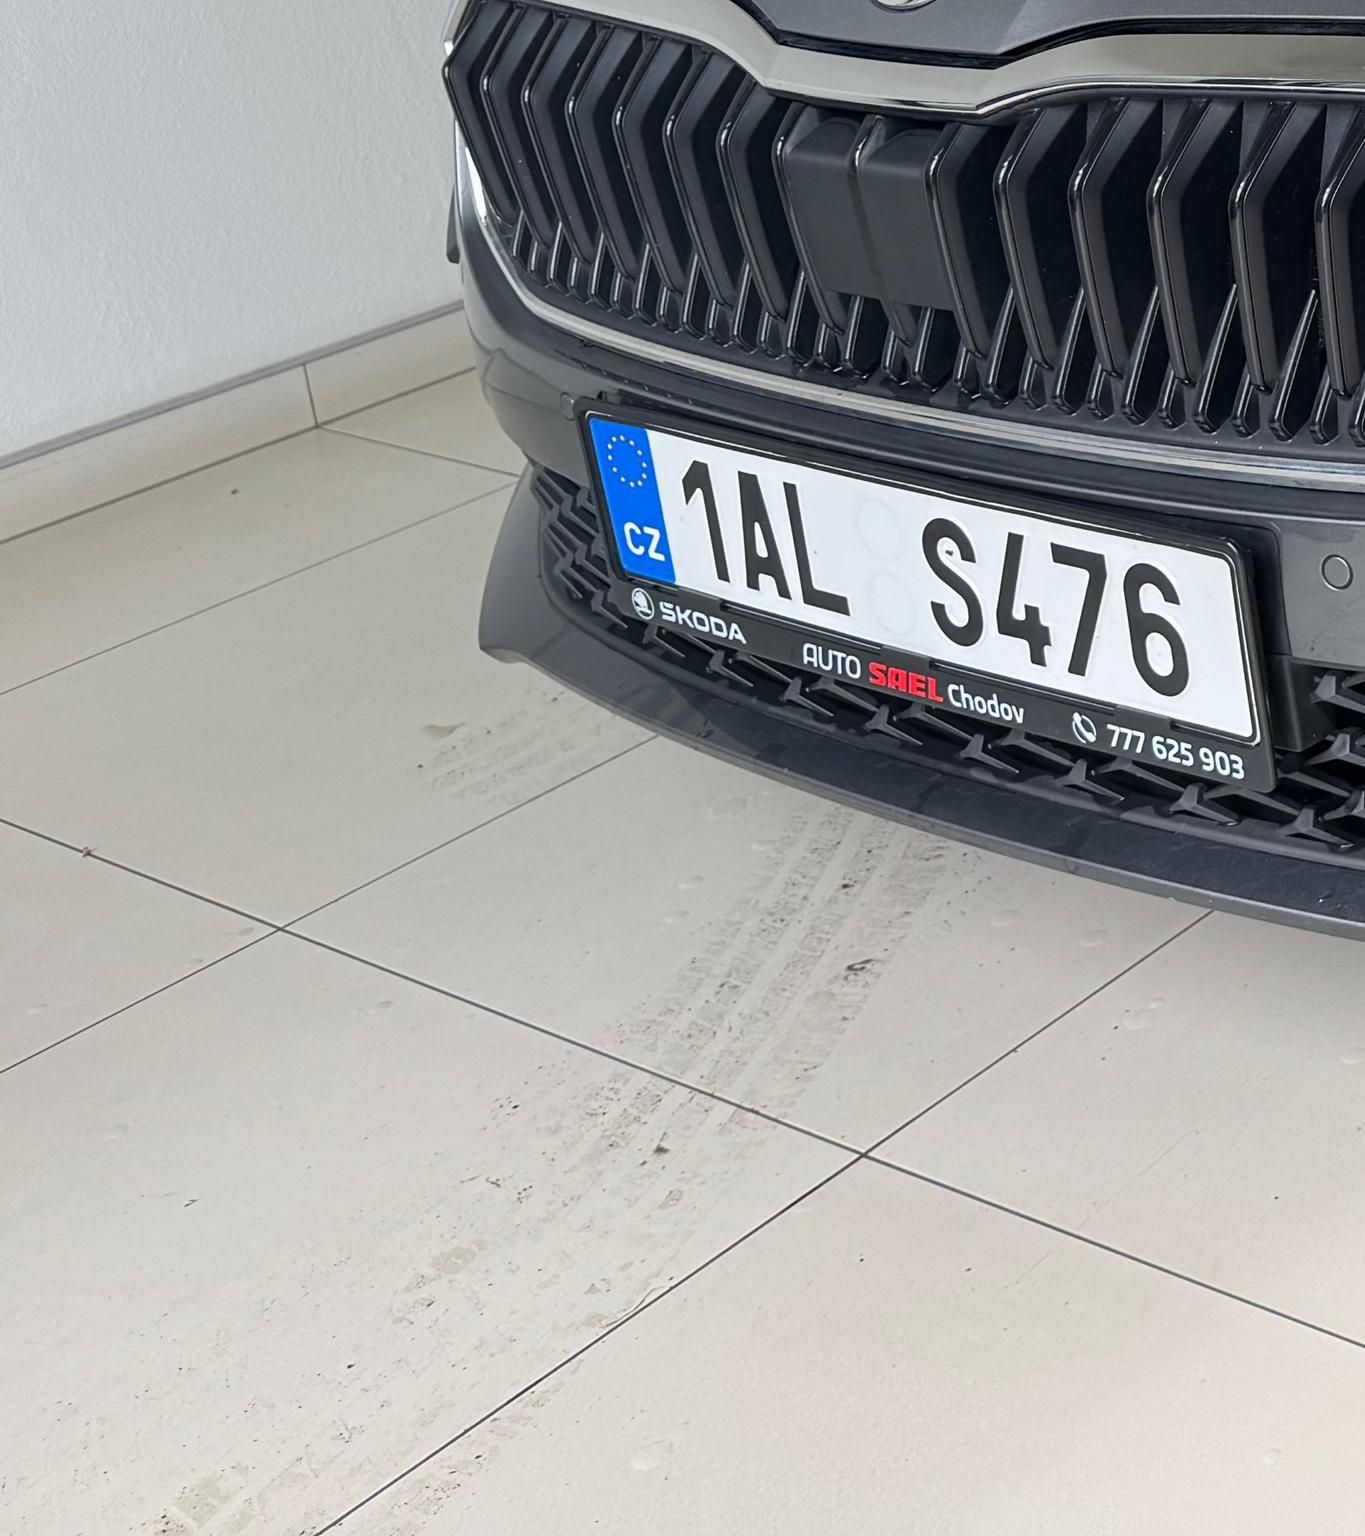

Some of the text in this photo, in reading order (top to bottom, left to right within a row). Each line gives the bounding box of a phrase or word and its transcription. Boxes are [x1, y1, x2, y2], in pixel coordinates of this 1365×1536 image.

[623, 521, 667, 563] CZ
[682, 460, 1190, 698] 1AL S476
[803, 643, 1024, 724] AUTO SAEL Chodov
[1106, 723, 1244, 780] 777 625 903
